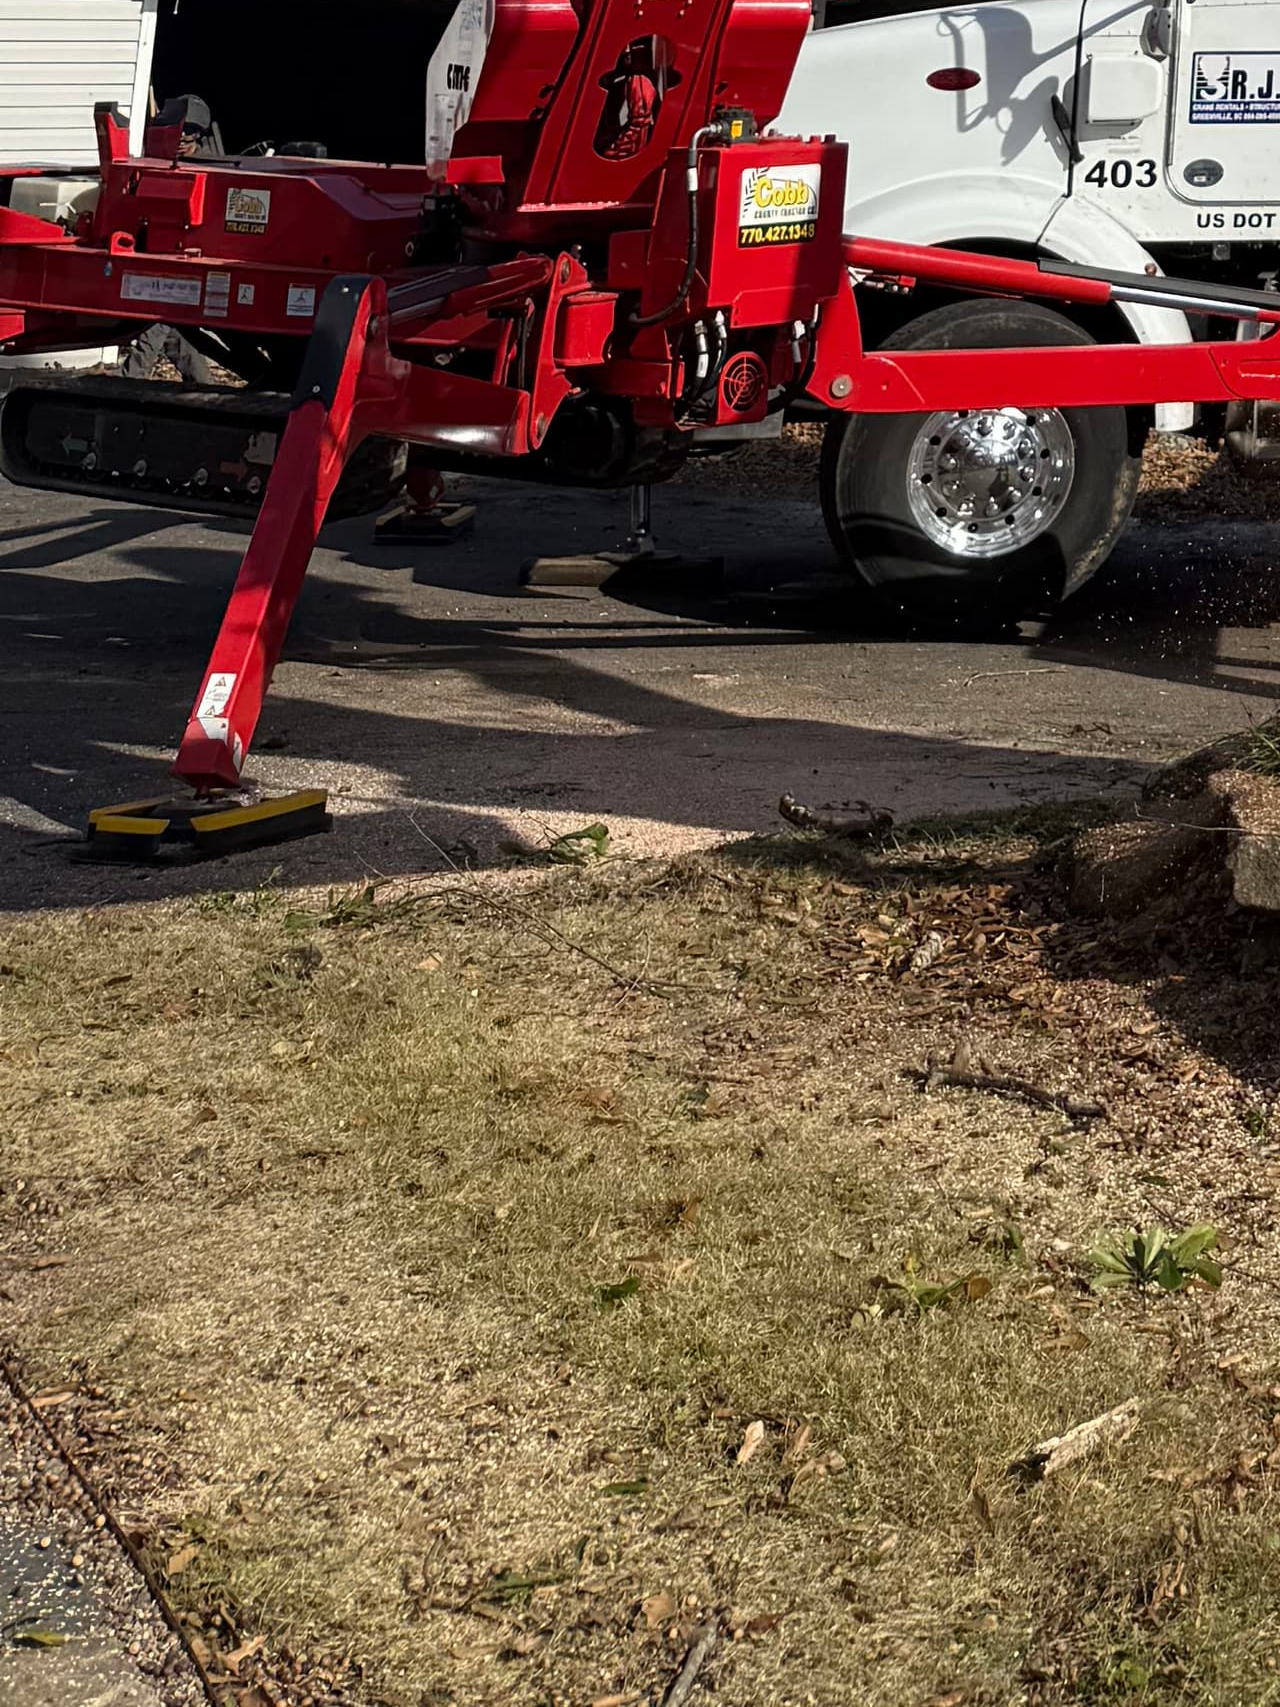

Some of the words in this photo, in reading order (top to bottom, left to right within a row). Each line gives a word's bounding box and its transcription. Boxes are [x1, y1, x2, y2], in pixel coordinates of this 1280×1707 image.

[1084, 159, 1158, 188] 403
[754, 177, 809, 208] Cobb
[1197, 213, 1225, 228] US
[1233, 213, 1276, 228] DOT
[741, 223, 815, 244] 770.427.1348
